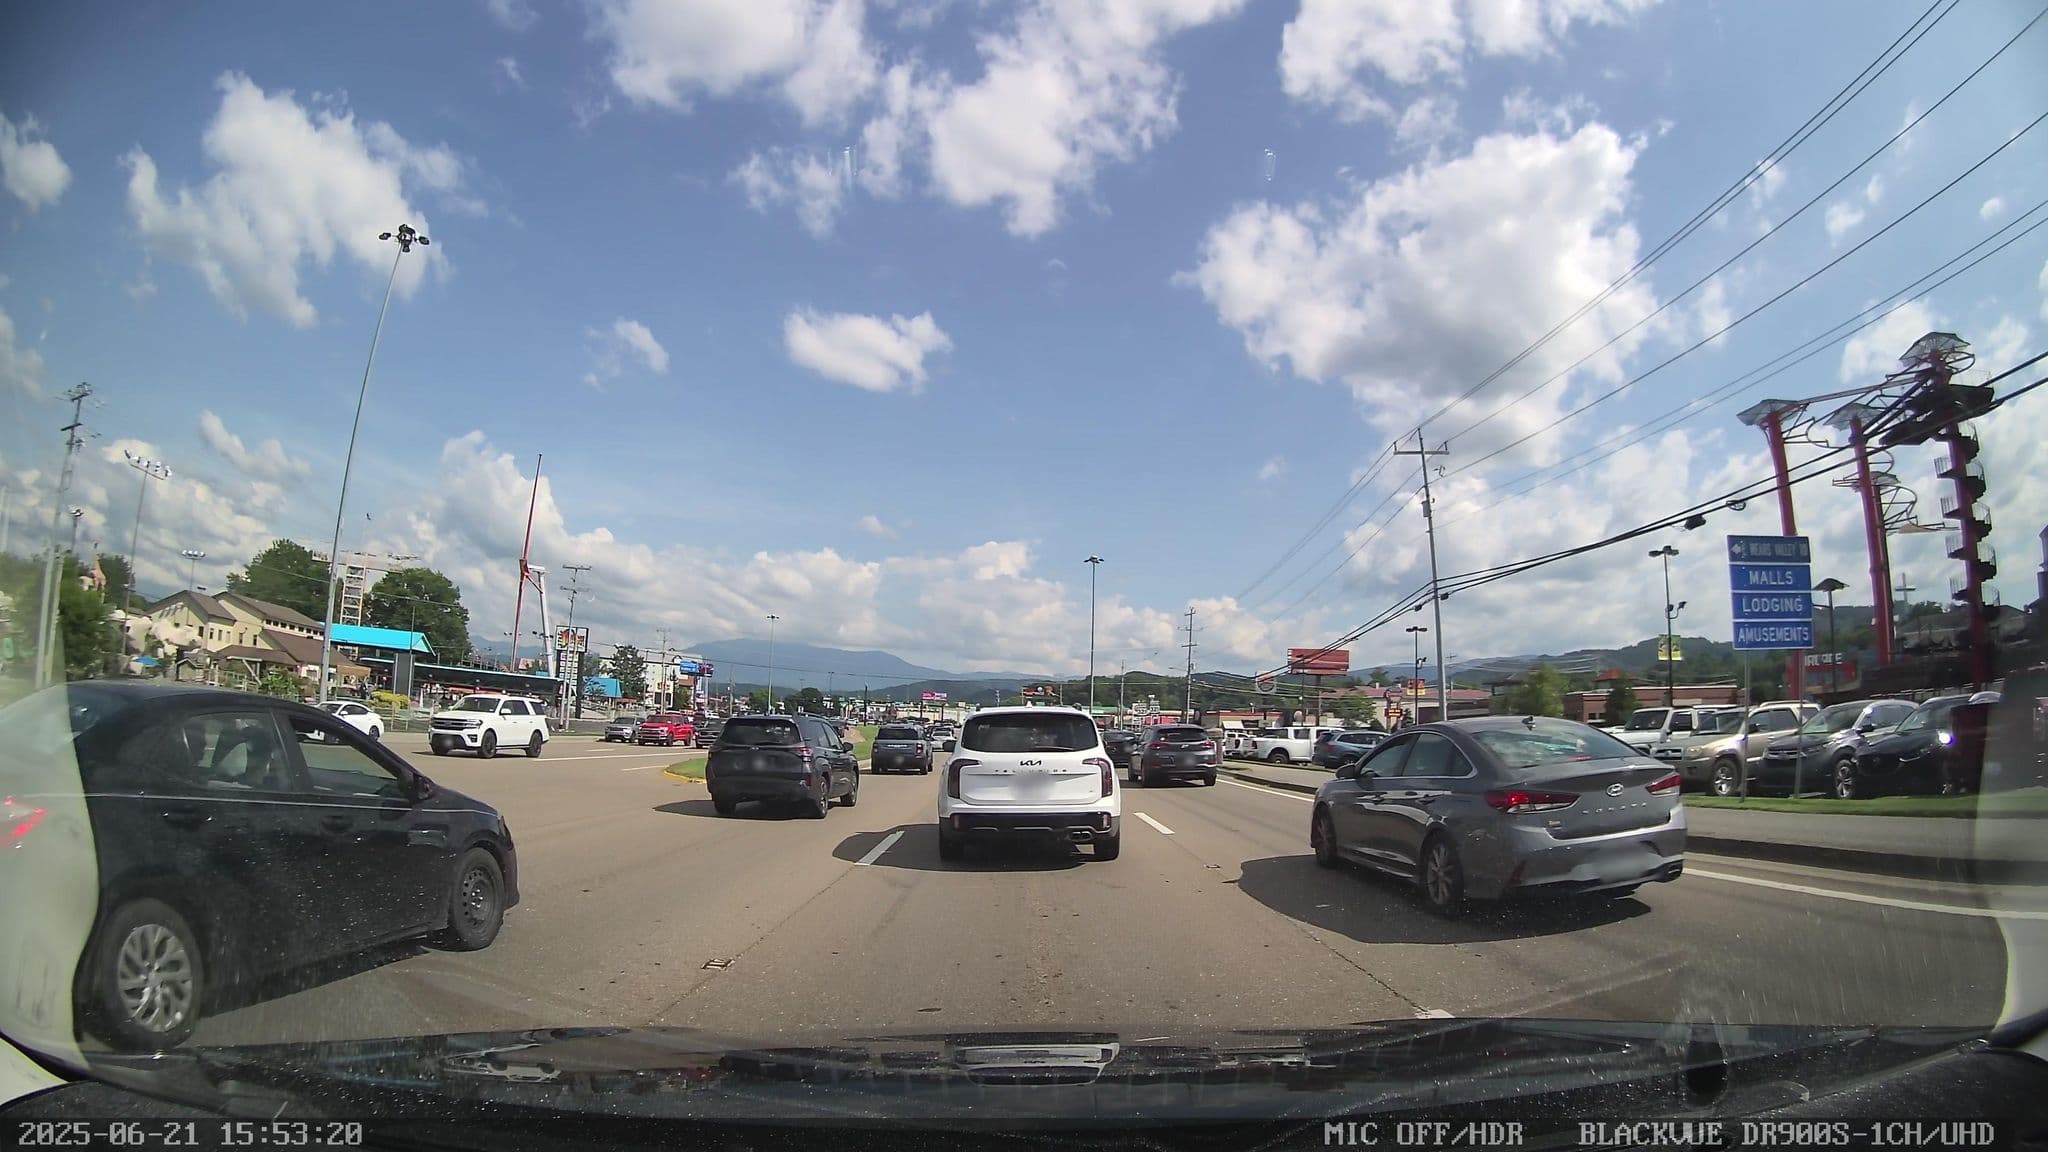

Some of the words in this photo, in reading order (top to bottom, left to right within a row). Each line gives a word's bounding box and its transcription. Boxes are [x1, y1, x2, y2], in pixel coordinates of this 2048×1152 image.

[1748, 570, 1793, 585] MALLS
[1742, 597, 1803, 613] LODGING
[1738, 627, 1809, 642] AMUSEMENTS
